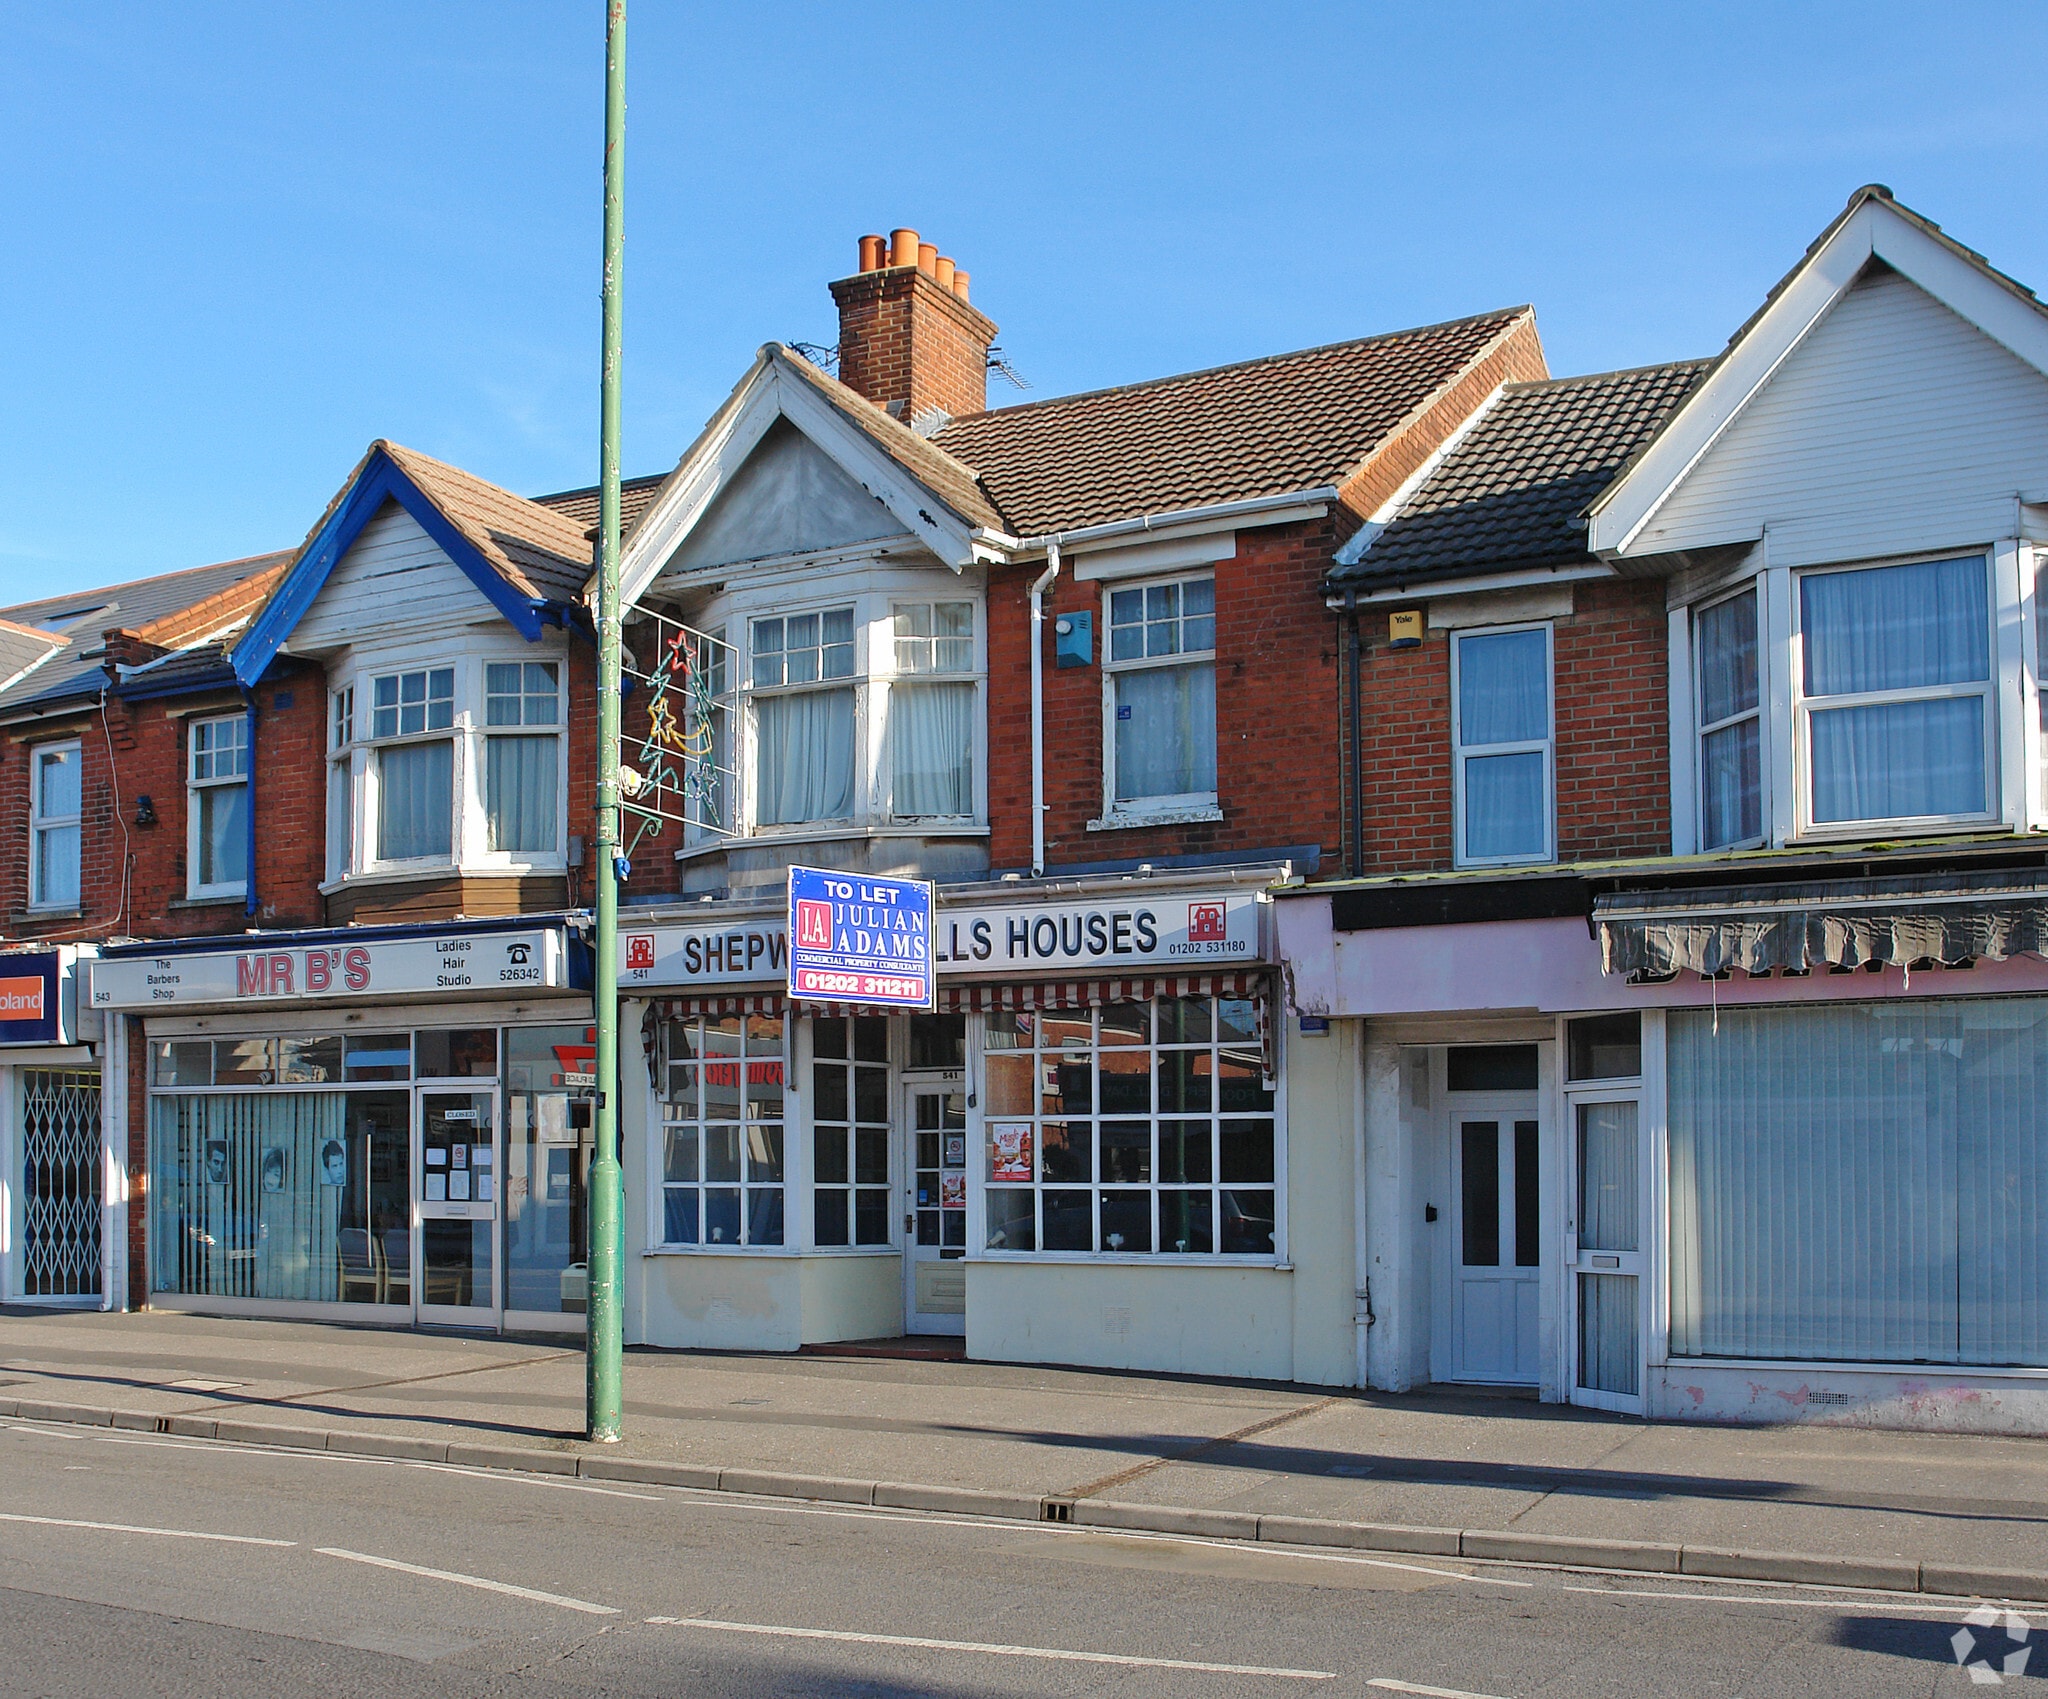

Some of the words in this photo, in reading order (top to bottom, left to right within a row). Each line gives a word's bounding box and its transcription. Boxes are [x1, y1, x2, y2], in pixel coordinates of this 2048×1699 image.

[1394, 615, 1413, 624] Yale
[824, 880, 854, 899] TO
[860, 884, 900, 905] LET
[835, 903, 924, 933] JULIAN
[436, 940, 472, 952] Ladies
[684, 931, 789, 974] SHEPW
[935, 920, 992, 962] LLS
[1007, 911, 1158, 959] HOUSES
[837, 928, 926, 959] ADAMS
[1169, 943, 1201, 955] 01202
[1206, 940, 1246, 953] 531180
[155, 959, 172, 970] The
[443, 957, 465, 969] Hair
[796, 953, 844, 965] COMMERCIAL
[844, 959, 879, 969] PROPERTY
[878, 962, 926, 972] CONSULTANTS
[236, 952, 295, 997] MR
[305, 946, 372, 992] B'S
[499, 967, 540, 981] 526342
[632, 969, 649, 980] 541
[147, 974, 181, 985] Barbers
[436, 974, 472, 987] Studio
[804, 972, 860, 992] 01202
[864, 977, 918, 997] 311211
[95, 992, 111, 1002] 543
[152, 988, 175, 1001] Shop
[942, 1072, 959, 1080] 541
[446, 1110, 476, 1119] CLOSED
